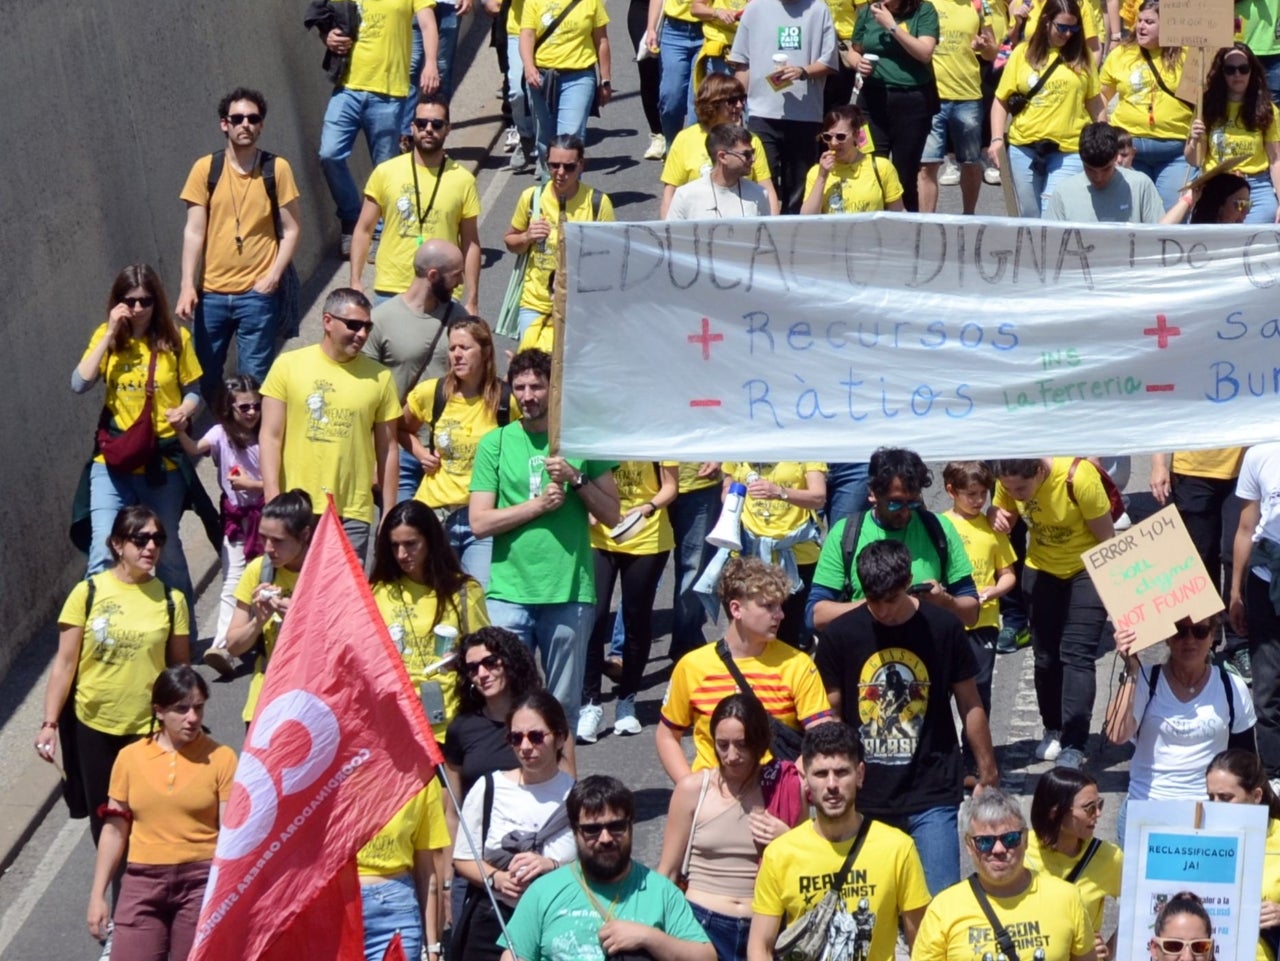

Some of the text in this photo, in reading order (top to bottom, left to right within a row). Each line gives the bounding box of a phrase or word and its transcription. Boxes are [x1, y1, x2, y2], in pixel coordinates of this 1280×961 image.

[781, 27, 799, 36] JO
[904, 223, 1094, 290] DIGNA
[742, 310, 1020, 356] Recursos
[742, 367, 976, 429] Ràtios
[1089, 516, 1176, 570] ERROR 404
[1116, 575, 1207, 630] NOT FOUND
[1149, 844, 1235, 858] RECLASSIFICACIÓ
[799, 869, 867, 894] REAON
[968, 920, 1041, 944] RESON
